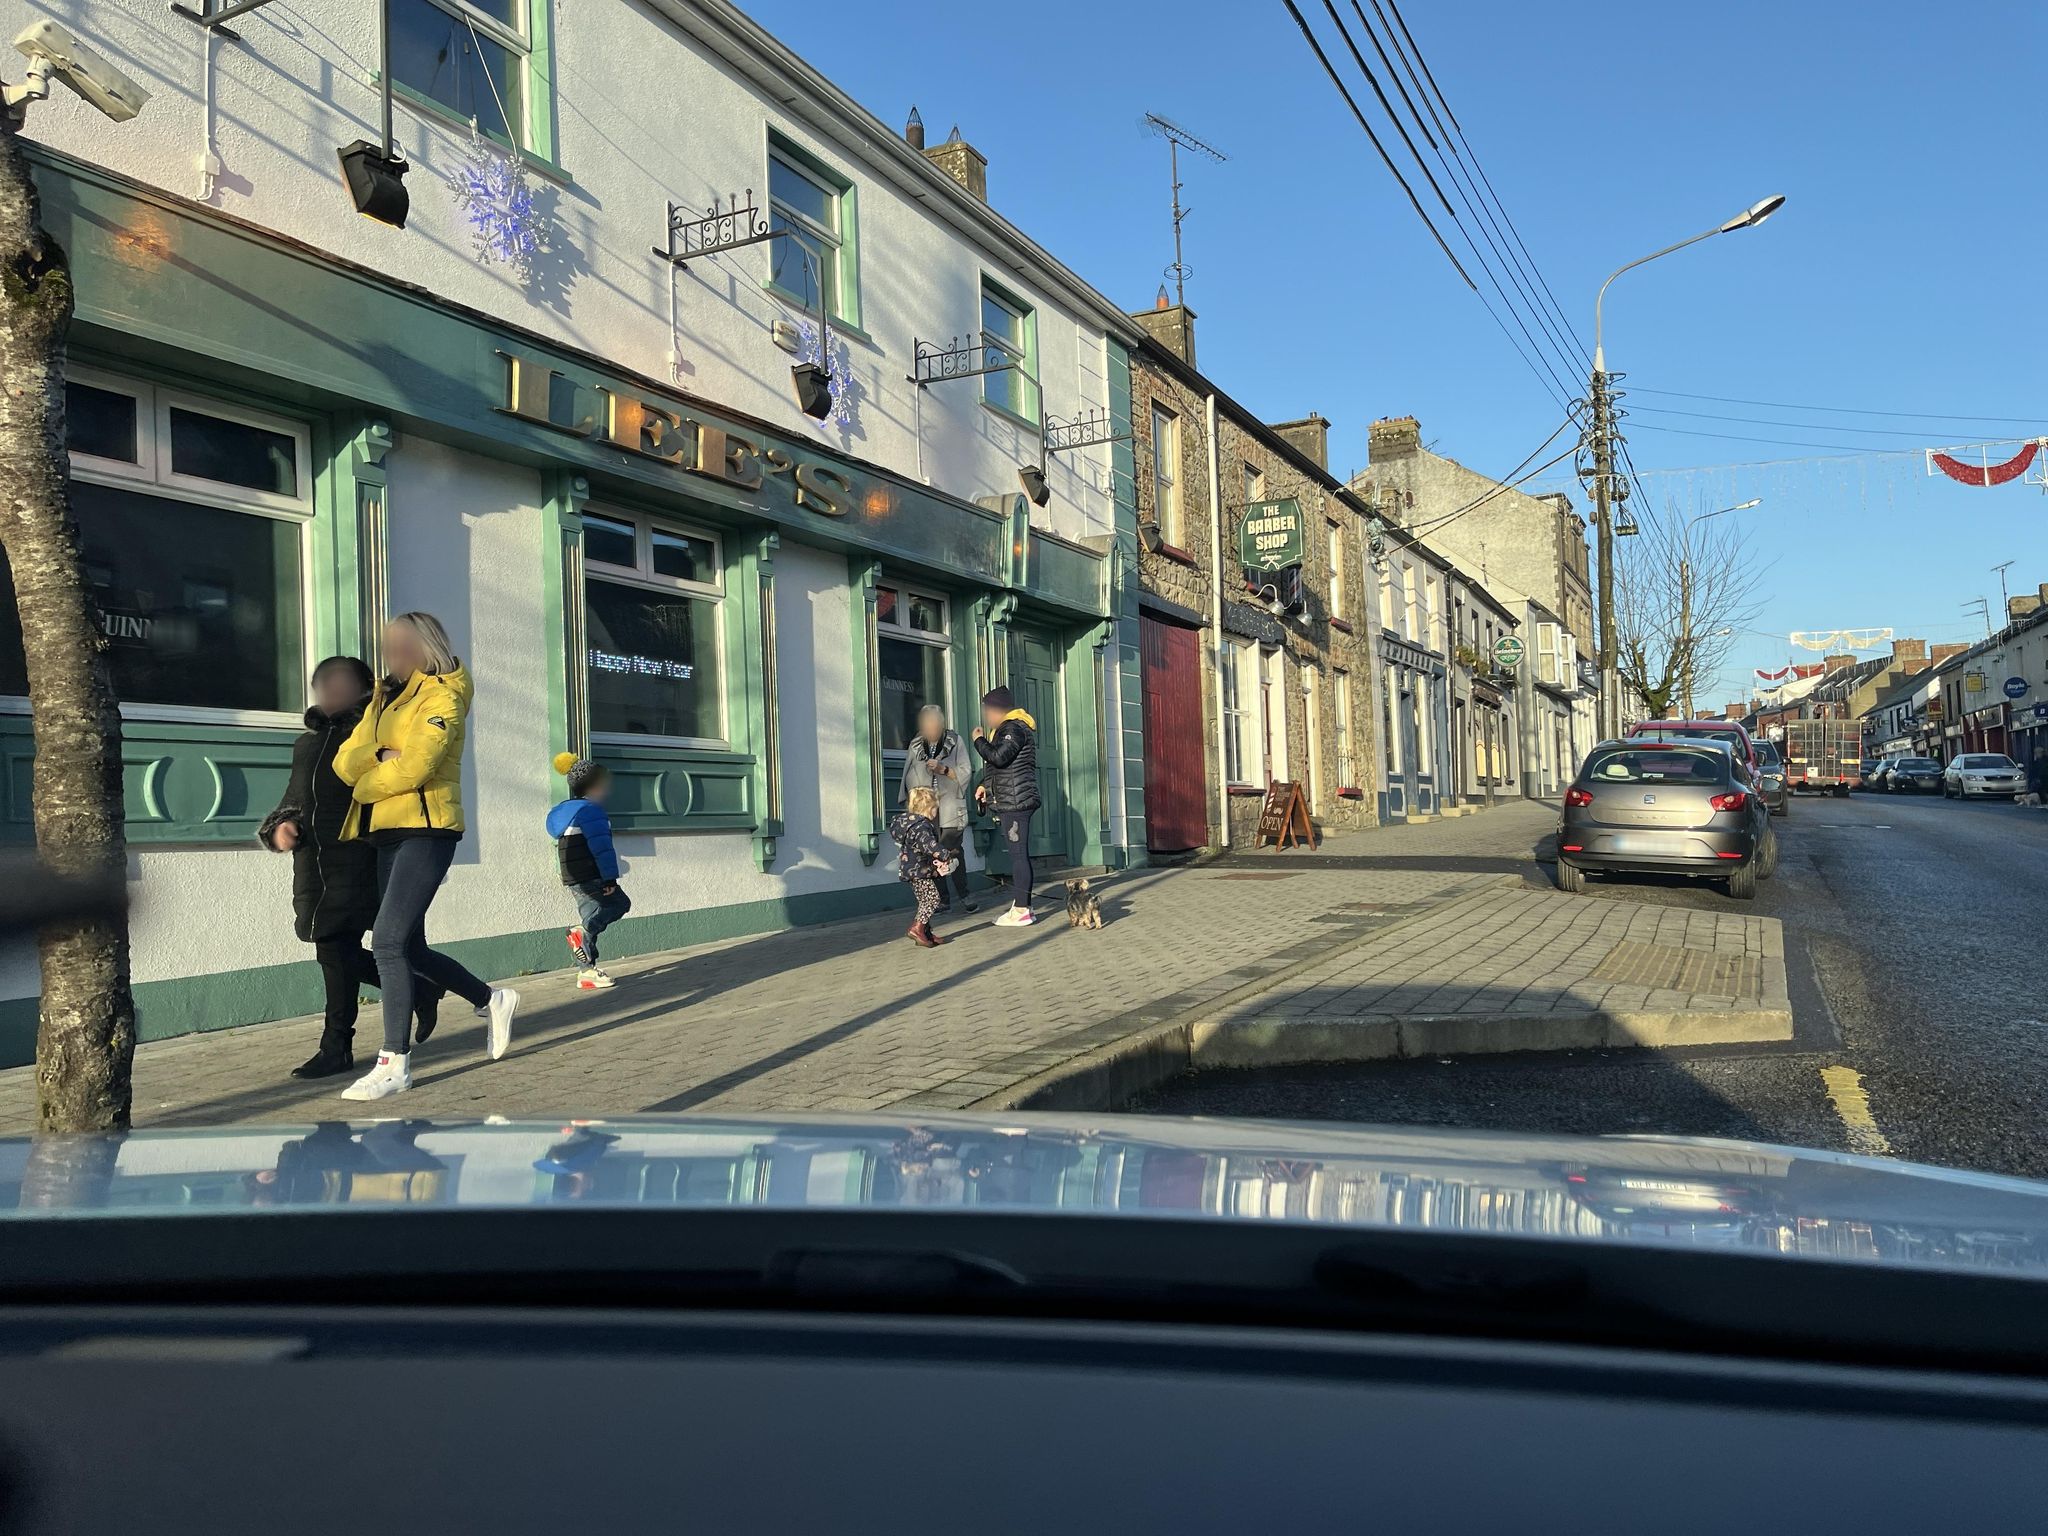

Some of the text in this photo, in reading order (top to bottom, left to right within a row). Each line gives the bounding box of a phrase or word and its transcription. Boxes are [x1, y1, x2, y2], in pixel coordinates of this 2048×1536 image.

[495, 347, 850, 517] LEE'S
[1263, 505, 1280, 517] THE
[1247, 515, 1296, 536] BARBER
[1256, 533, 1289, 551] SHOP
[589, 649, 693, 679] Happy New Year
[882, 676, 914, 693] GUINNESS
[1261, 816, 1284, 831] OPEN
